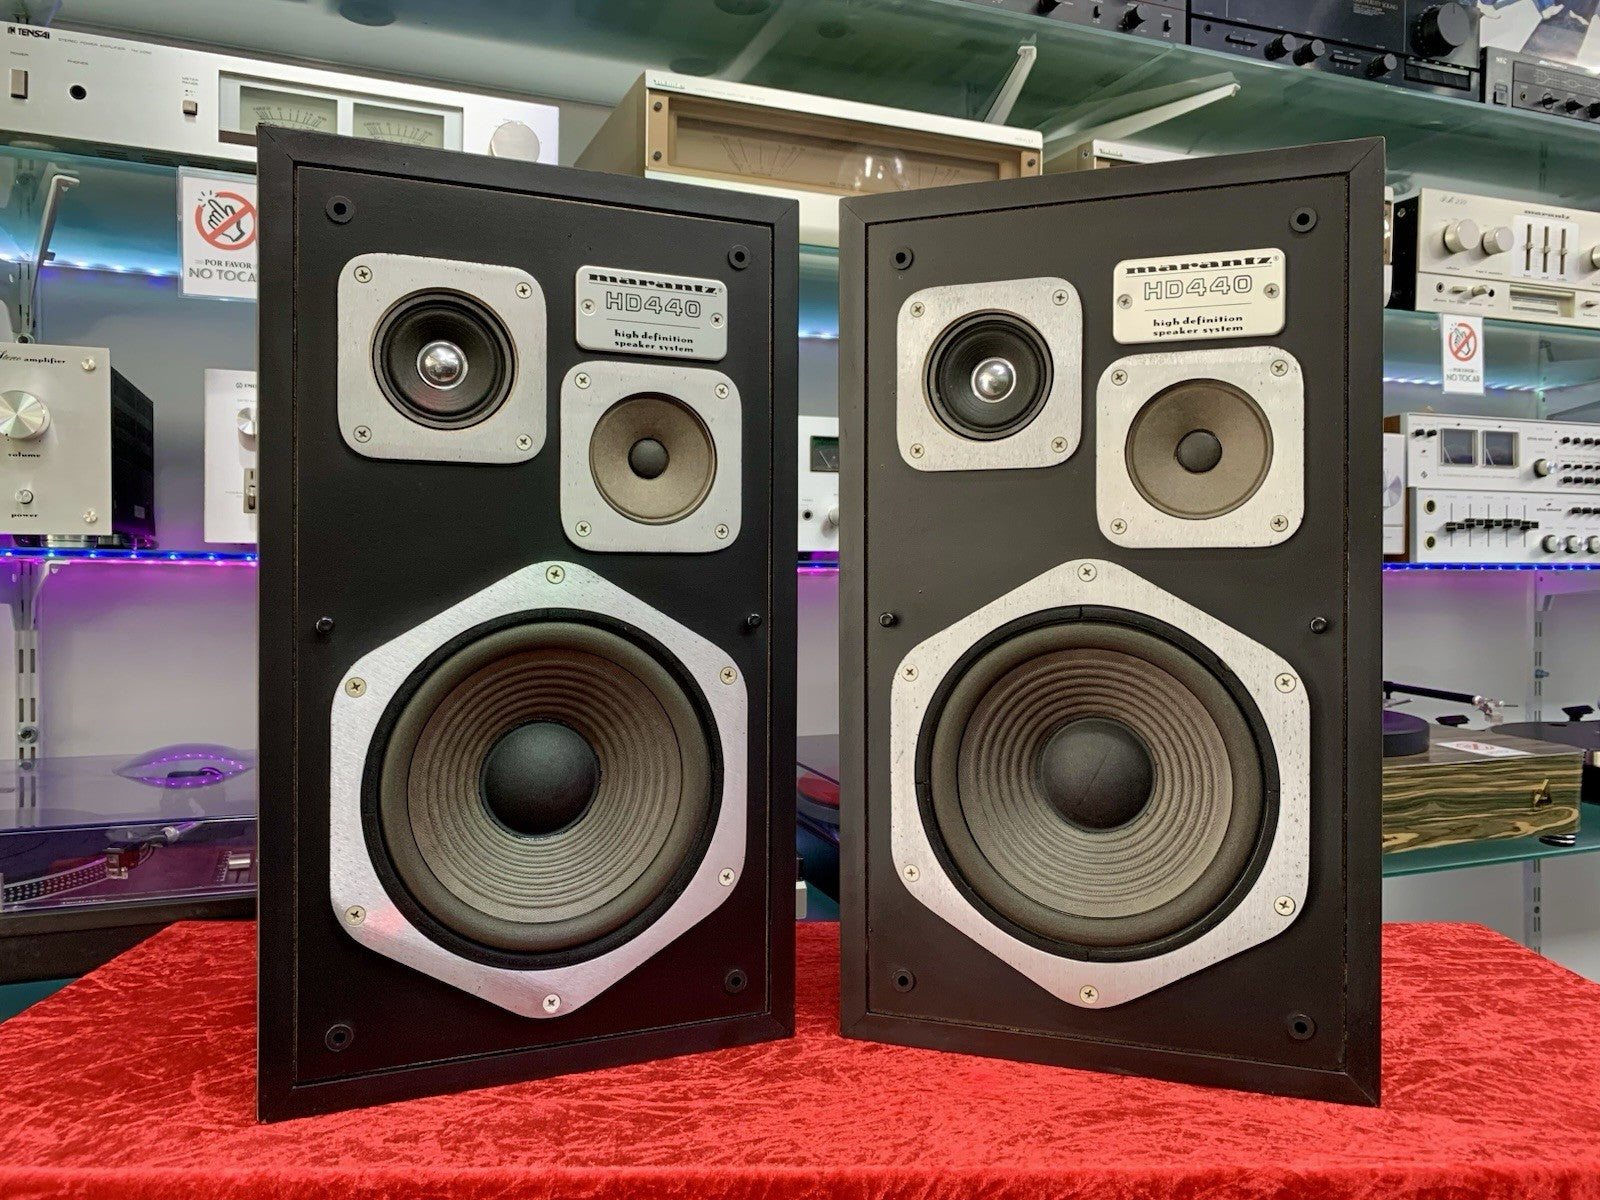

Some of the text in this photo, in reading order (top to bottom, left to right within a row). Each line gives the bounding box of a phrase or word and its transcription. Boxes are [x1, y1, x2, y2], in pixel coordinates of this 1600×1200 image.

[18, 27, 51, 40] TENSAI
[205, 259, 252, 269] POR FAVOR
[1126, 257, 1273, 275] marantz
[189, 267, 258, 283] NO TOCA
[589, 274, 718, 295] marantz
[1143, 275, 1253, 301] HD440
[605, 291, 702, 318] HD440
[1153, 315, 1244, 328] high definition
[614, 329, 694, 345] high definition
[1153, 325, 1244, 338] speaker system
[614, 340, 695, 354] speaker system
